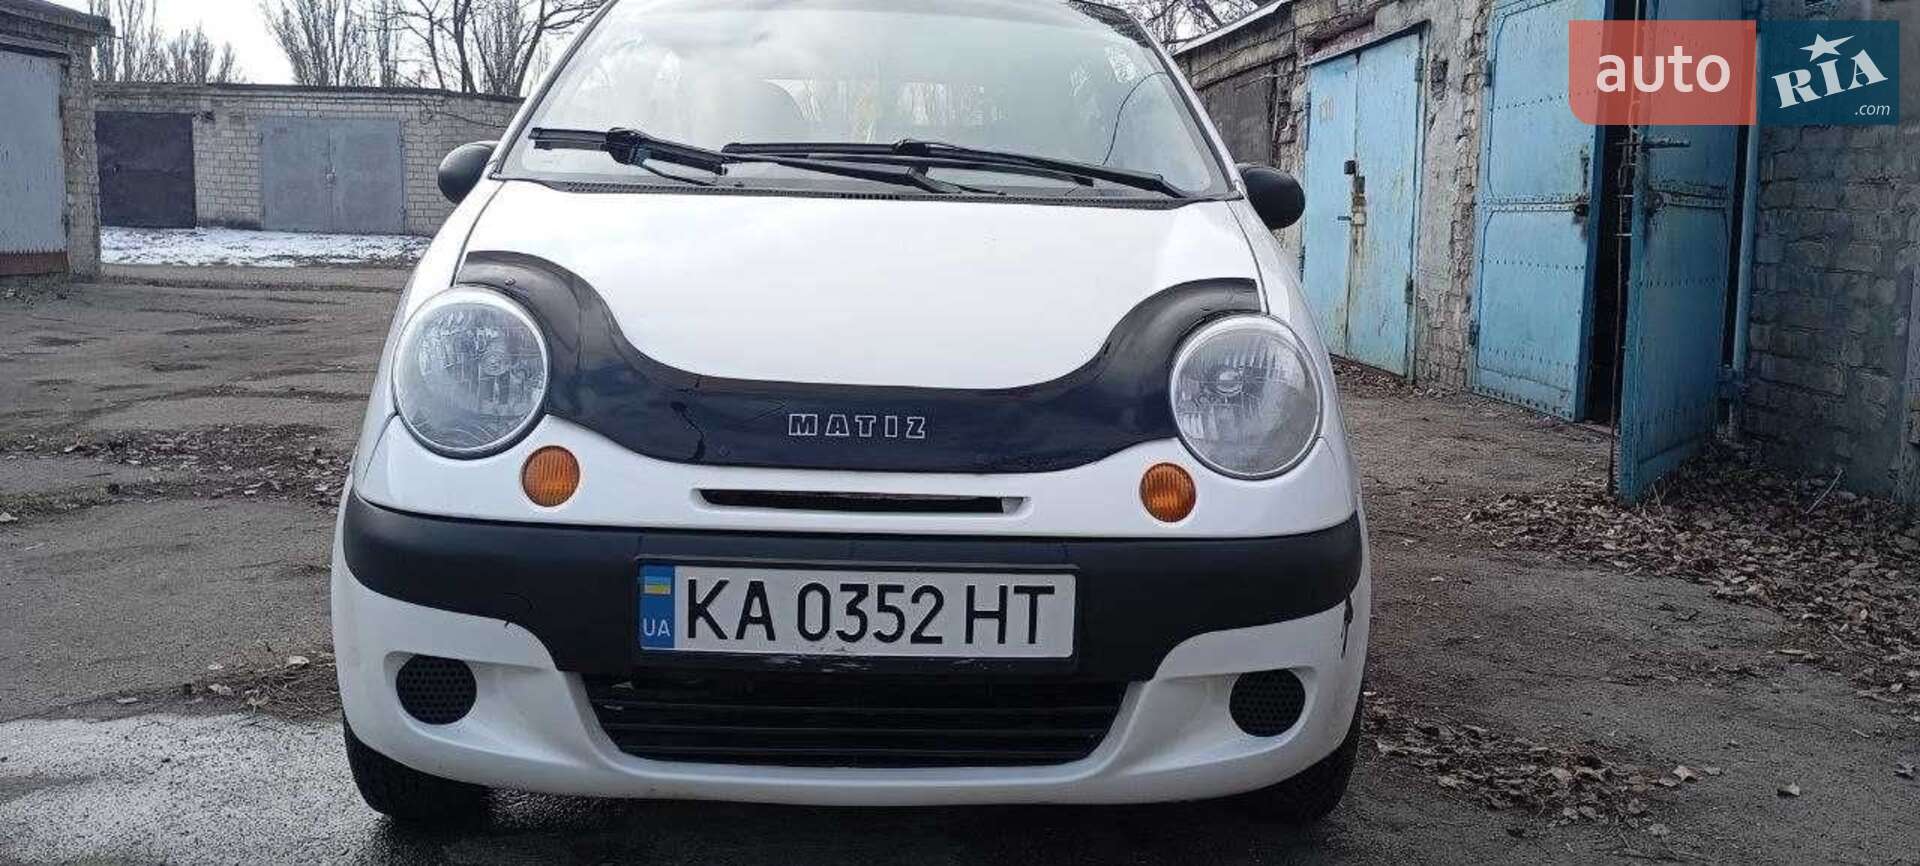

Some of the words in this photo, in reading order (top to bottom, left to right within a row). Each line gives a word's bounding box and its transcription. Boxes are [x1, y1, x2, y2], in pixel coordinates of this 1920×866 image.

[788, 413, 926, 439] MATIZ
[686, 578, 777, 642] KA
[796, 581, 945, 645] 0352
[964, 584, 1056, 645] HT
[642, 618, 671, 638] UA
